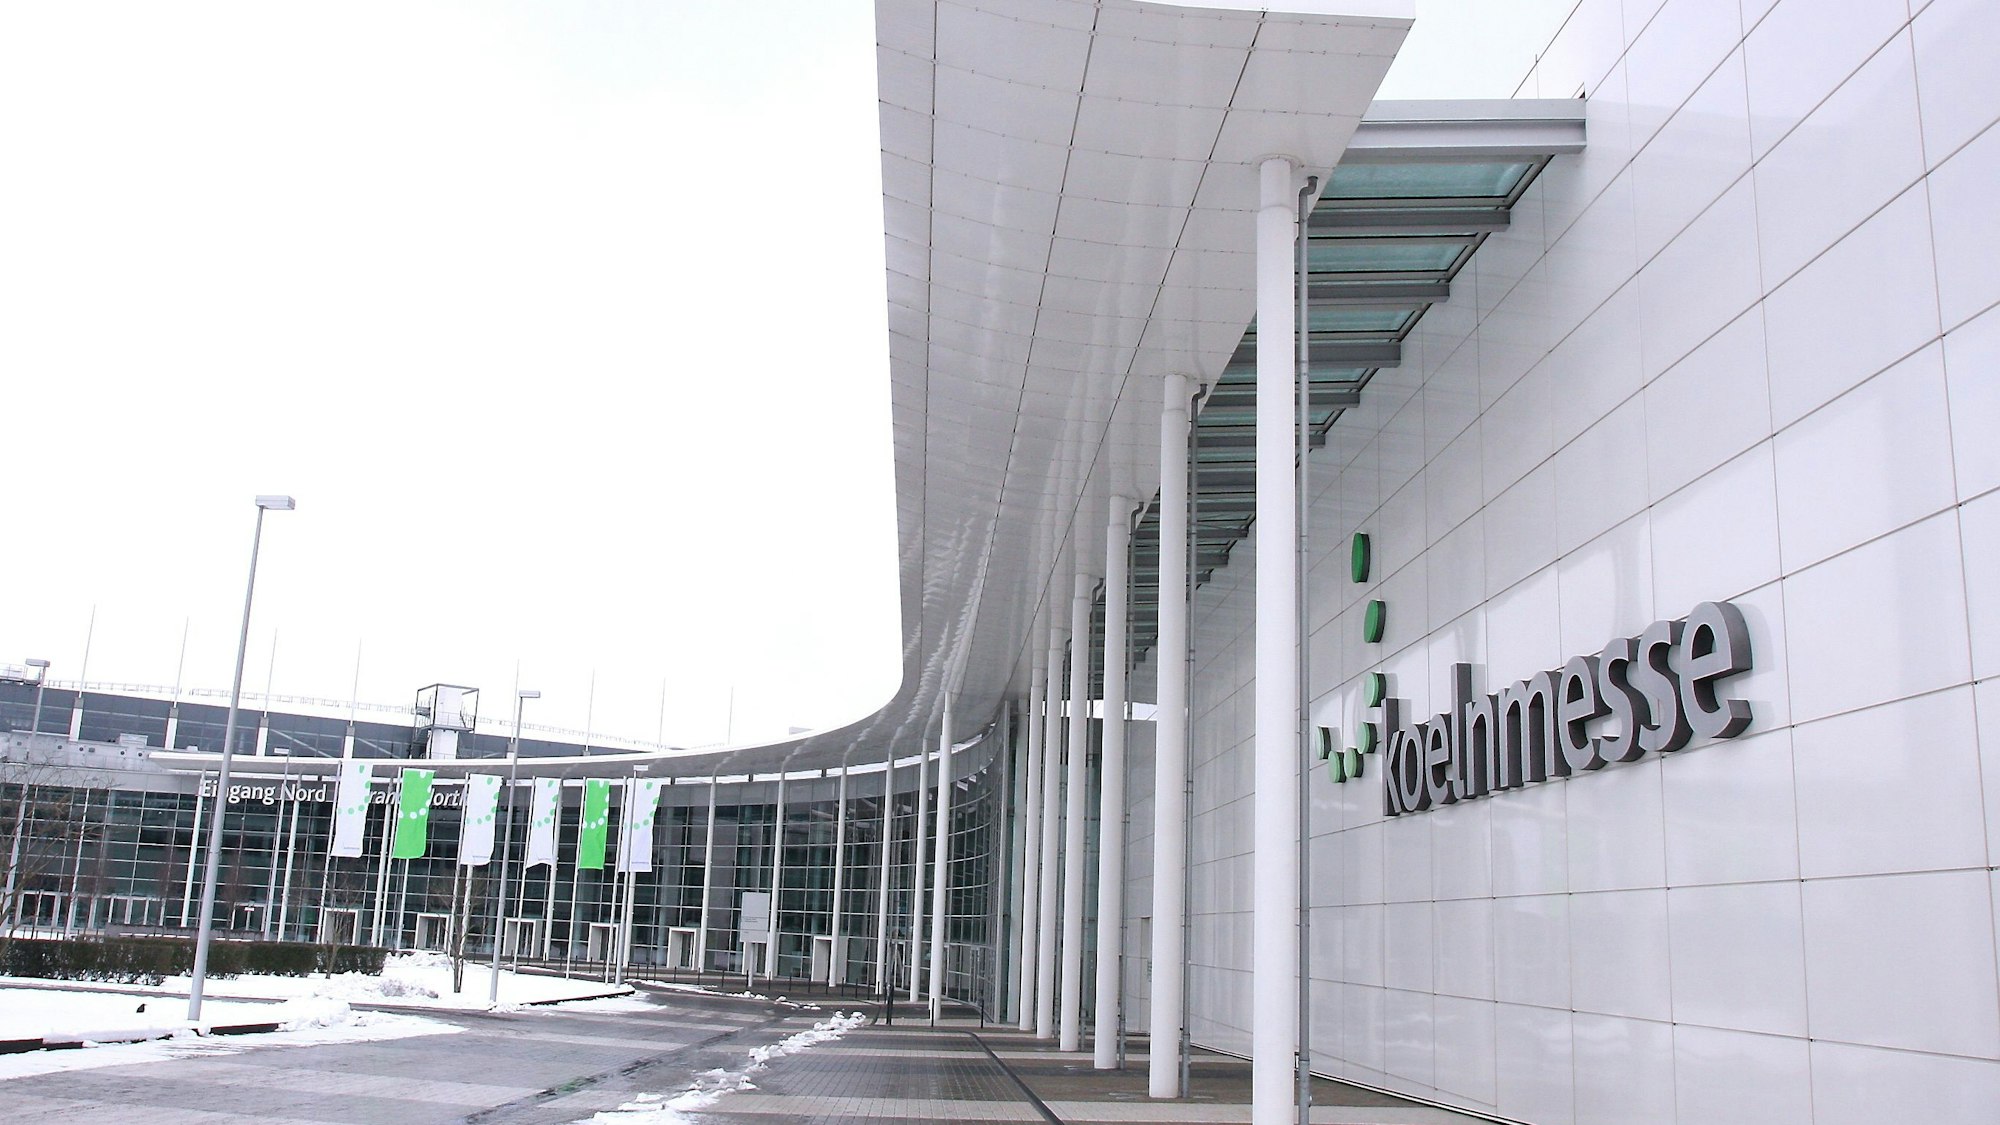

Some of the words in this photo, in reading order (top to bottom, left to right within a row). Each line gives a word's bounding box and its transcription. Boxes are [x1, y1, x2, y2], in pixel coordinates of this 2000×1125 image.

[1382, 601, 1752, 816] koelnmesse
[201, 779, 276, 805] Eigang
[281, 783, 327, 803] Nord
